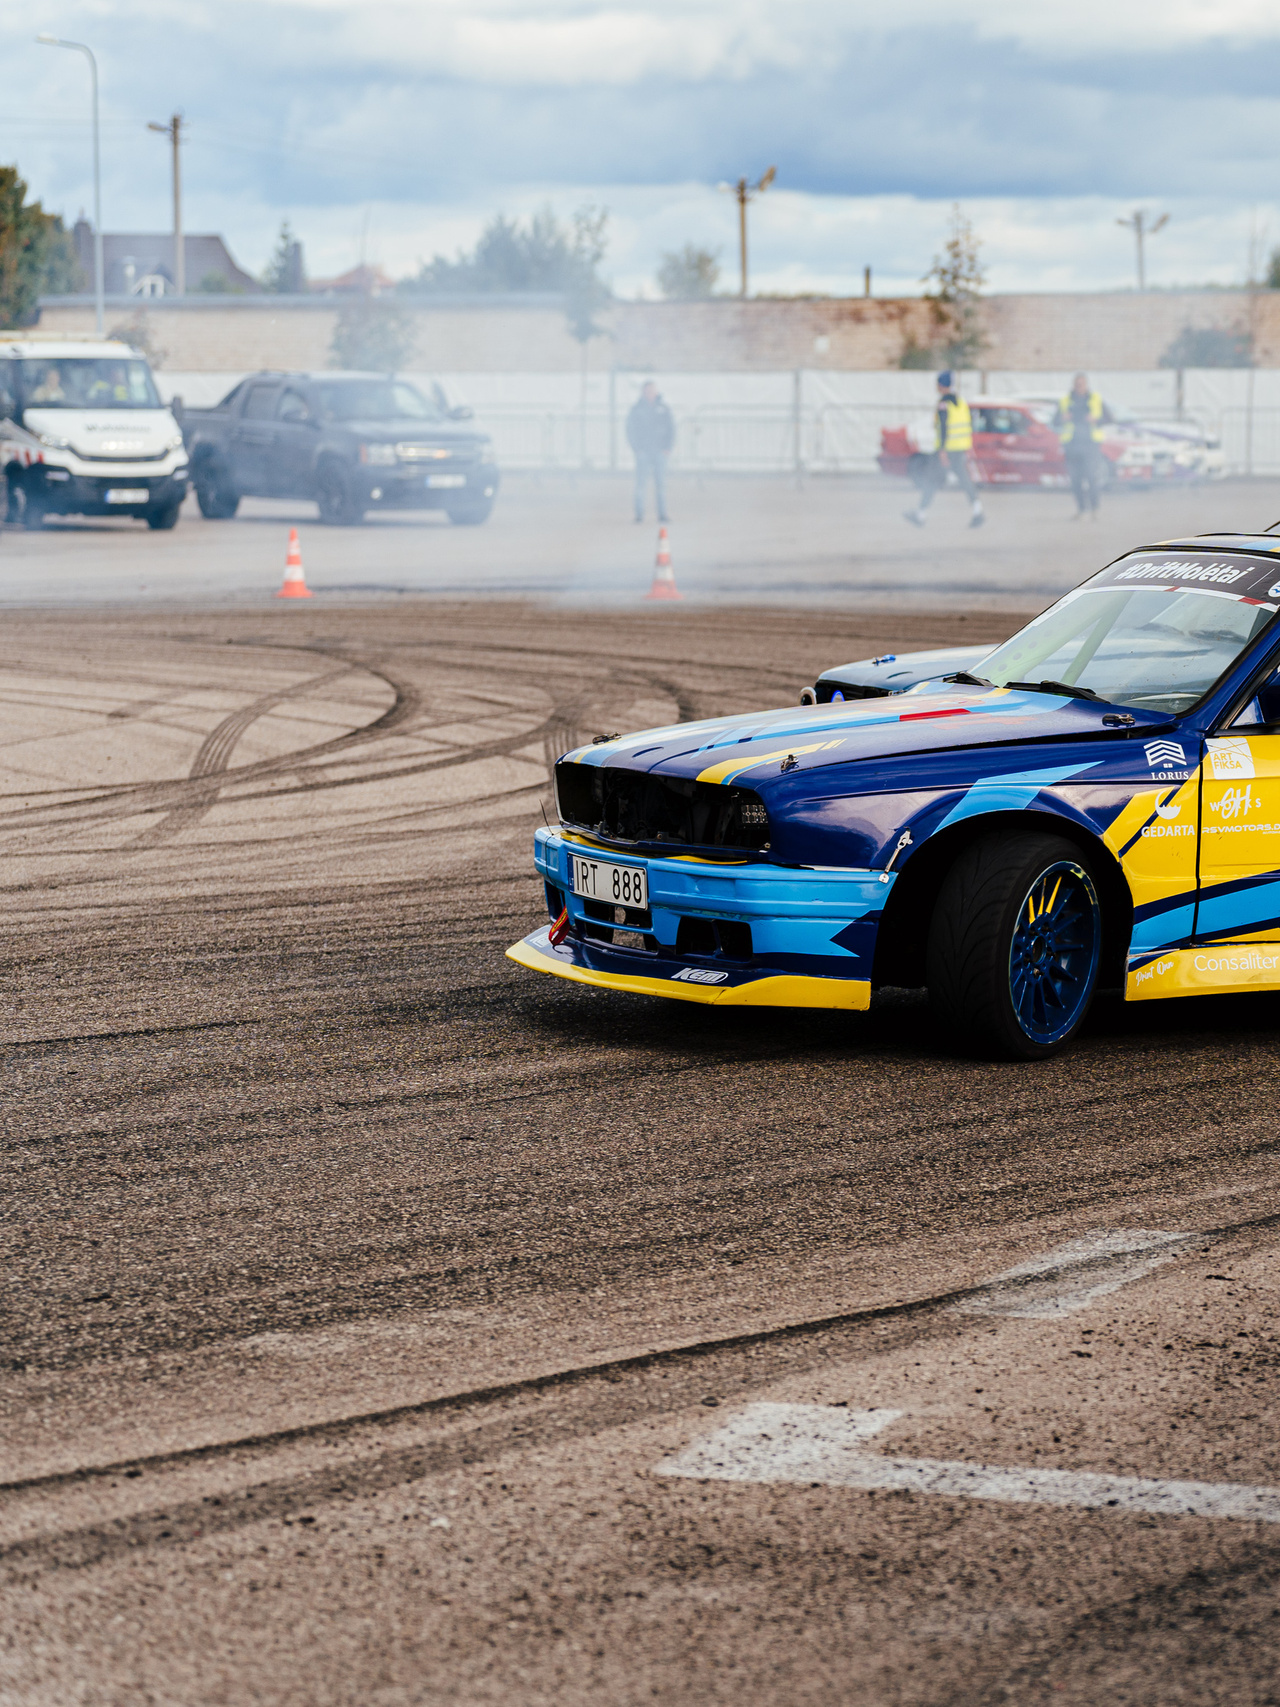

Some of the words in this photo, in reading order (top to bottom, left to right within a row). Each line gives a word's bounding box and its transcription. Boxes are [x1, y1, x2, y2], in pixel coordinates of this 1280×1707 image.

[1213, 752, 1233, 761] ART
[1213, 760, 1243, 770] FIKSA
[1150, 771, 1190, 780] LORUS
[1141, 824, 1196, 838] GEDARTA
[575, 860, 599, 896] IRT
[611, 868, 643, 904] 888
[1193, 952, 1280, 972] Consaliter
[1135, 966, 1155, 987] Print
